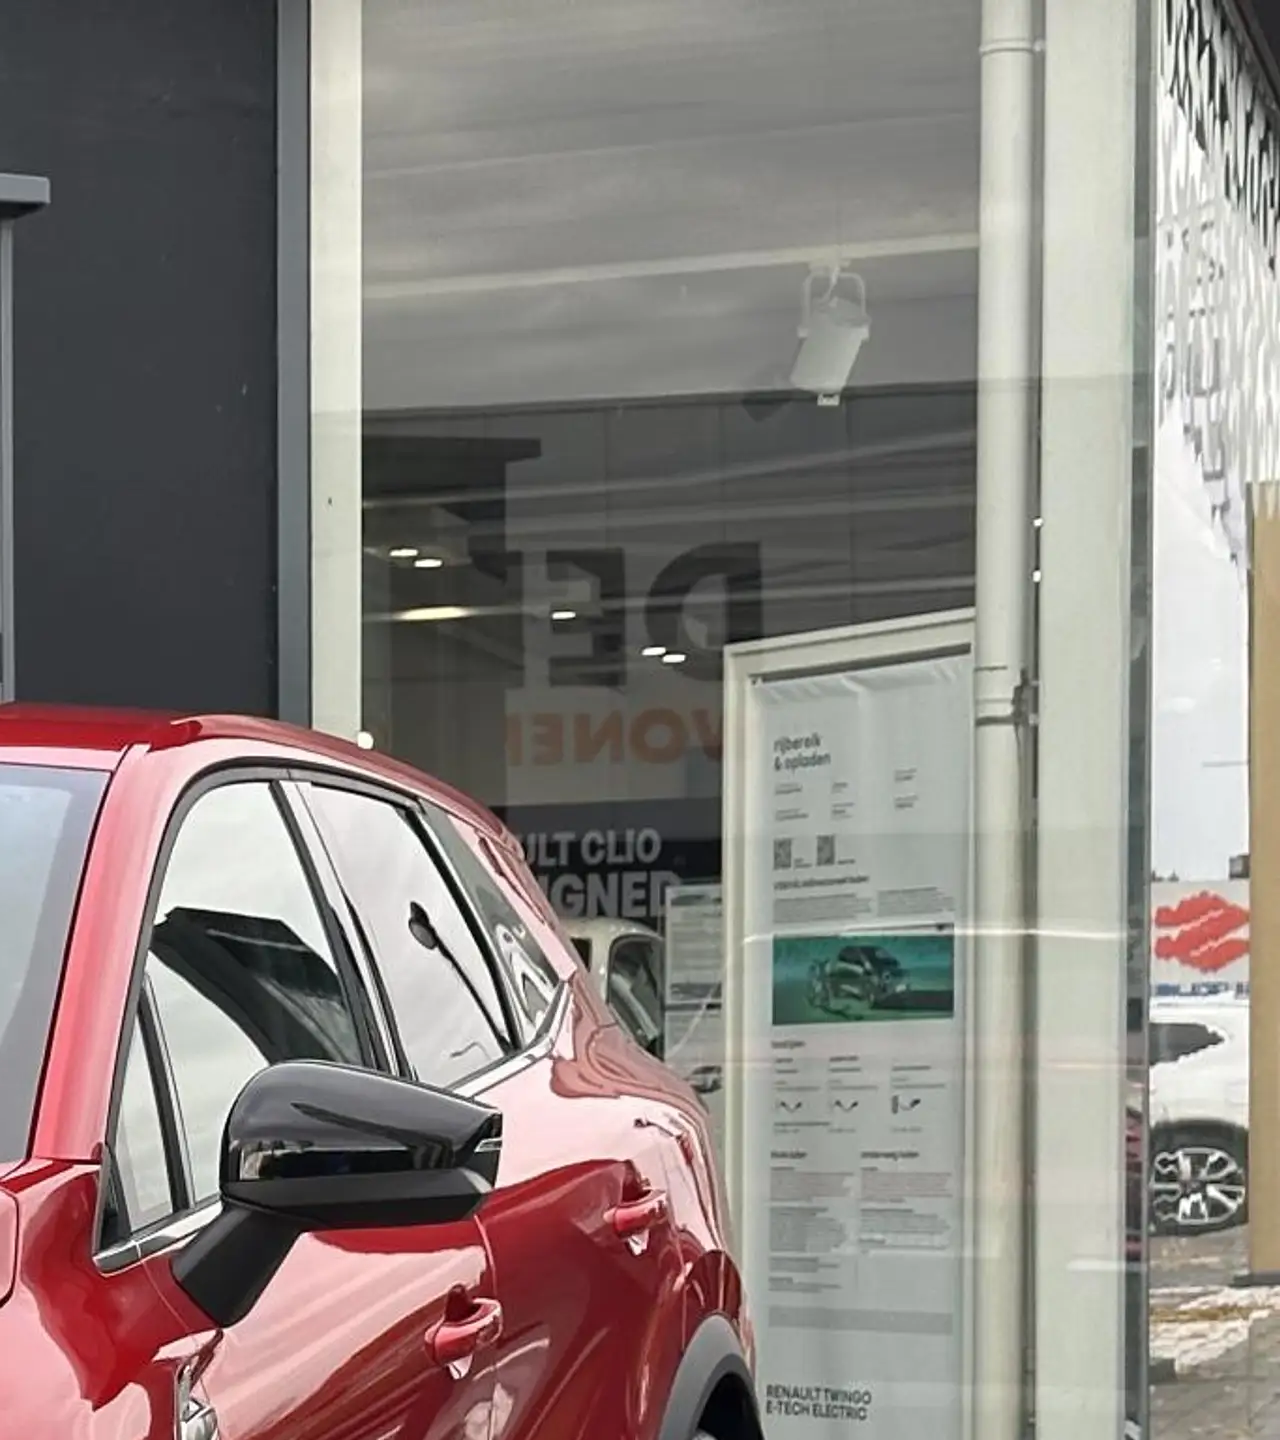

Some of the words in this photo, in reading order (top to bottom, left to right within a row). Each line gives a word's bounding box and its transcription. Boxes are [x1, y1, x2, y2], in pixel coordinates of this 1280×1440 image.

[581, 826, 662, 865] CLIO
[766, 1384, 821, 1401] RENAULT
[824, 1387, 872, 1405] TWINGO
[766, 1400, 811, 1416] E-TECH
[812, 1402, 868, 1421] ELECTRIC
